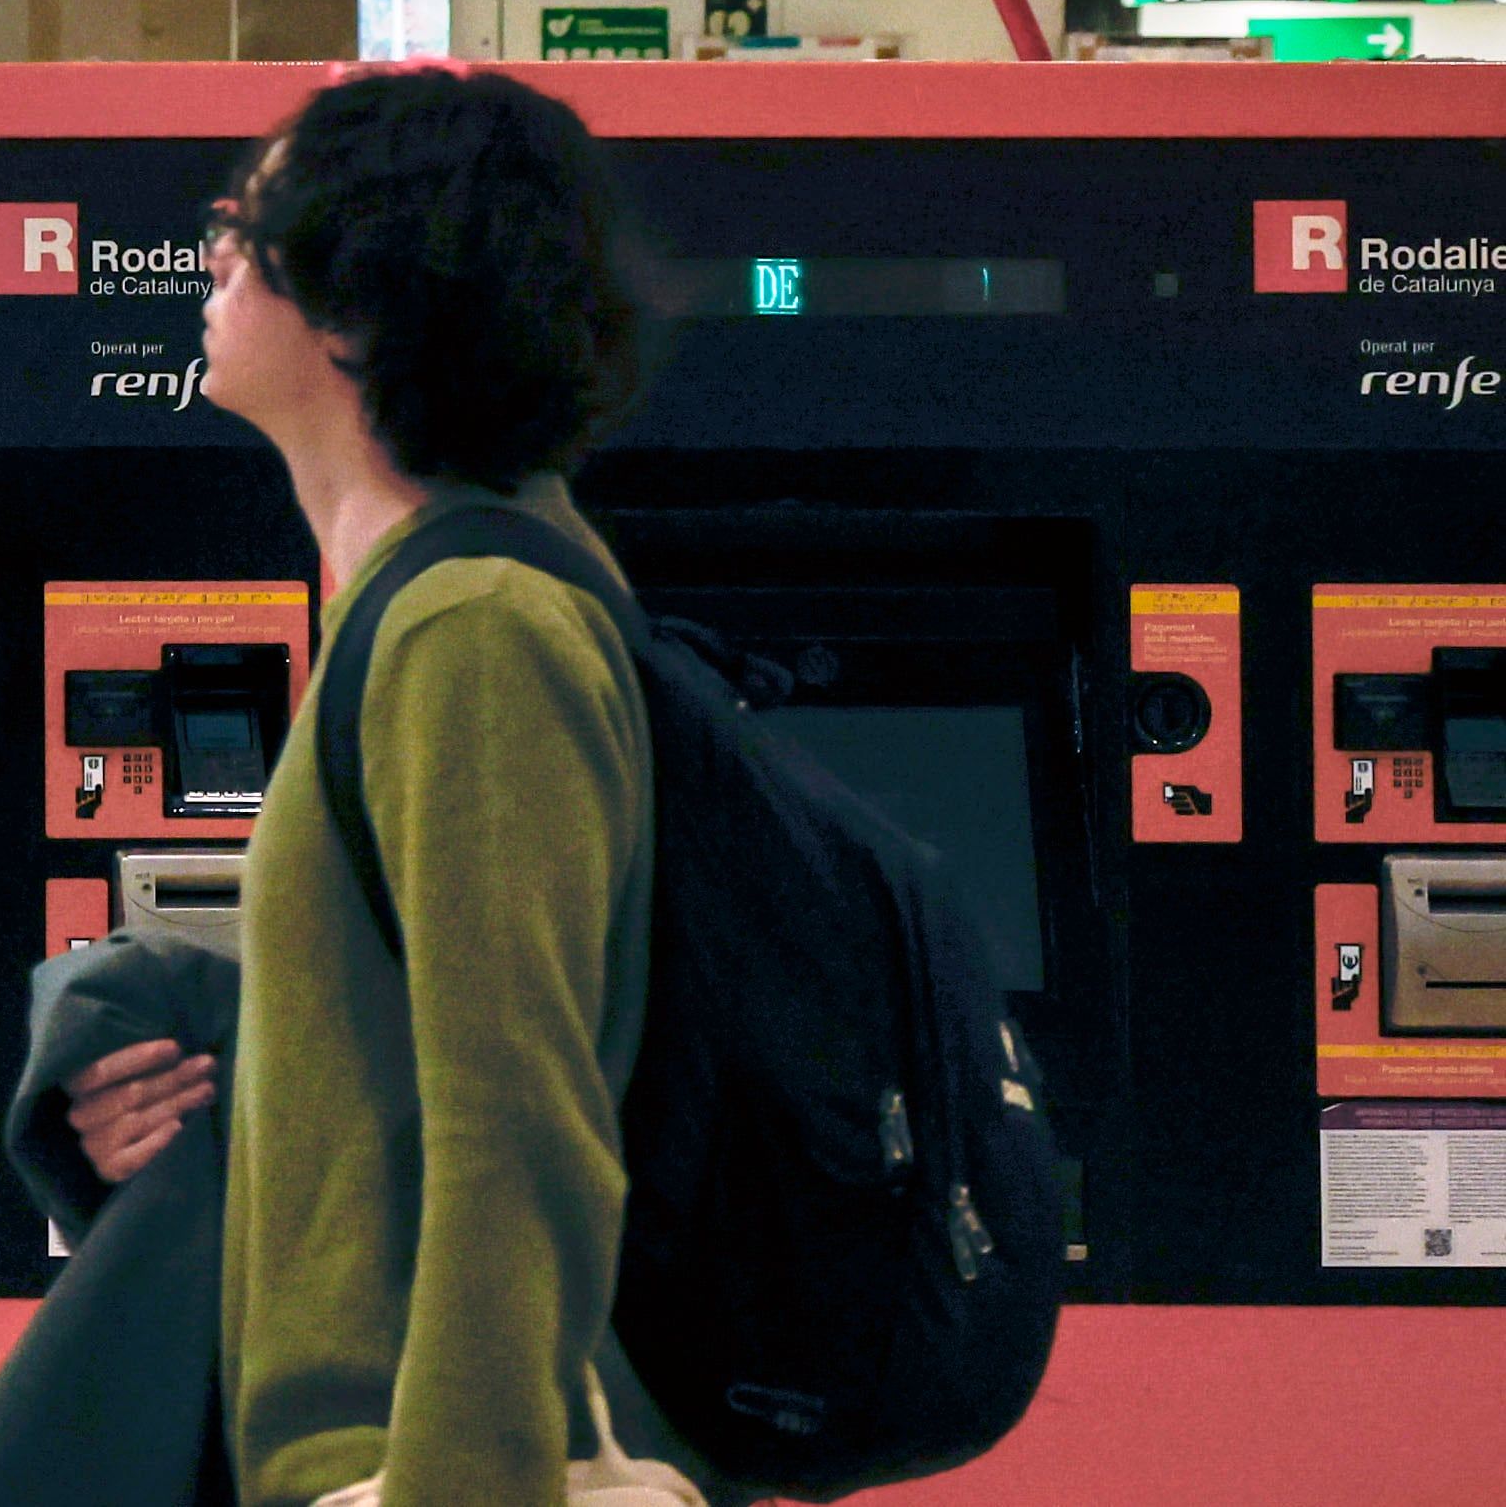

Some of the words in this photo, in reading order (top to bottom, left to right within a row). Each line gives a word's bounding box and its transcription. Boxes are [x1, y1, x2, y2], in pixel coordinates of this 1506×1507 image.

[23, 217, 75, 273] R
[92, 240, 207, 272] Rodal
[1291, 215, 1343, 270] R
[1360, 237, 1506, 270] Rodalie
[89, 277, 116, 296] de
[119, 274, 215, 302] Cataluny
[756, 264, 799, 309] DE
[1358, 274, 1386, 293] de
[1391, 274, 1495, 297] Catalunya
[90, 341, 137, 357] Operat
[142, 344, 163, 358] per
[1360, 338, 1407, 355] Operat
[1412, 340, 1435, 356] per
[91, 357, 205, 412] renf
[1360, 355, 1501, 410] renfe
